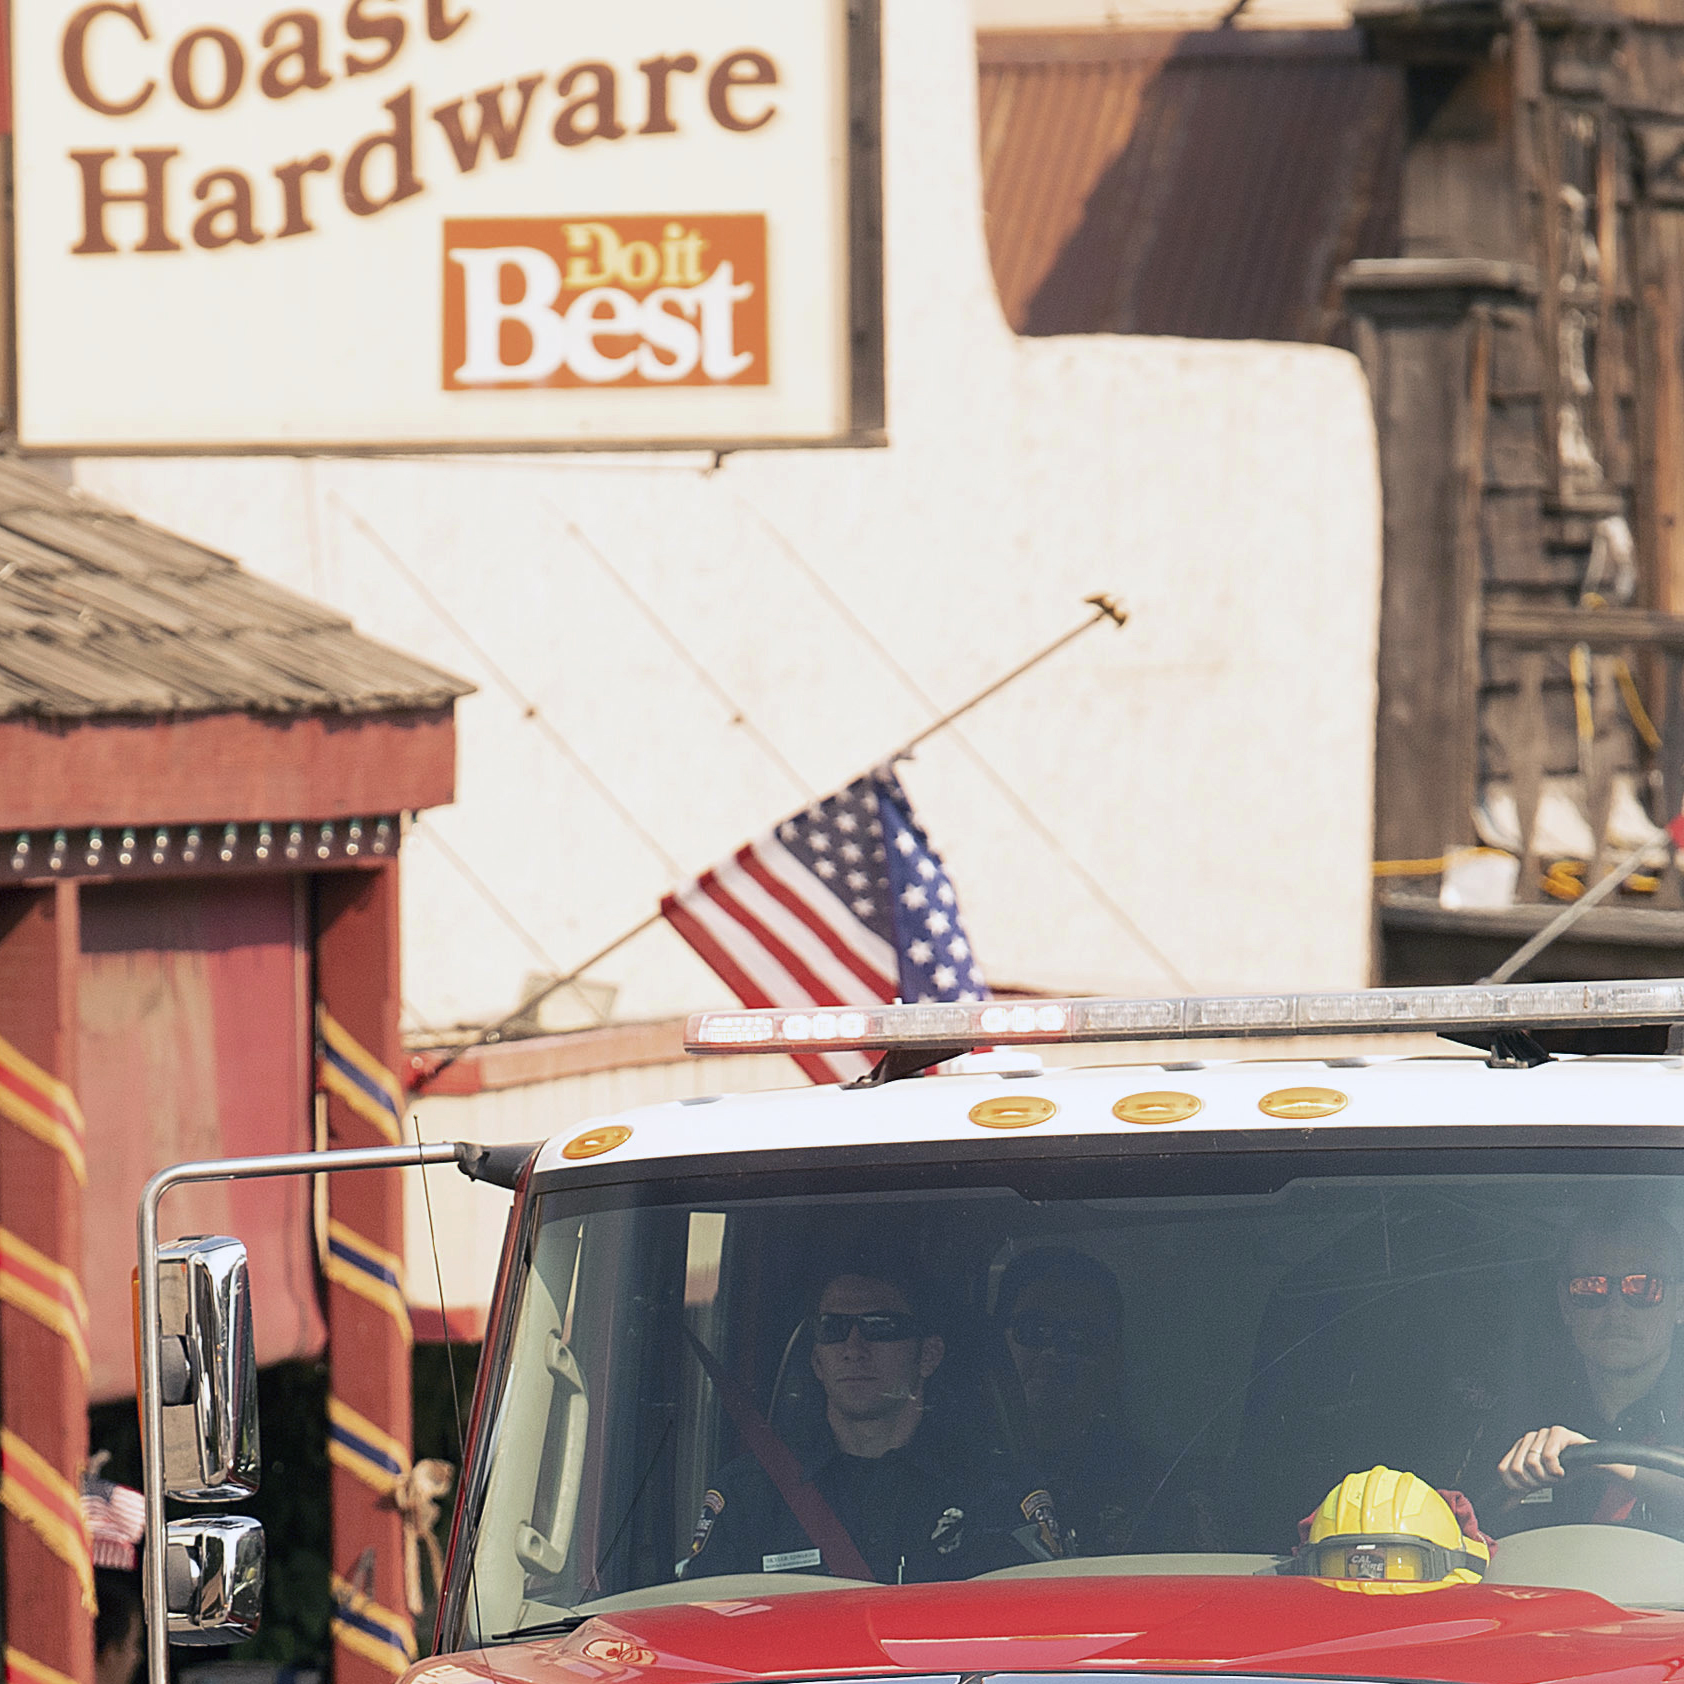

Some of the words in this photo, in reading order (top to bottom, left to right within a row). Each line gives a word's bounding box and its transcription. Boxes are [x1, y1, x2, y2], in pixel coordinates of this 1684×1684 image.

[70, 48, 781, 254] Hardware
[448, 246, 755, 382] Best
[562, 222, 660, 288] Do
[660, 222, 710, 285] it
